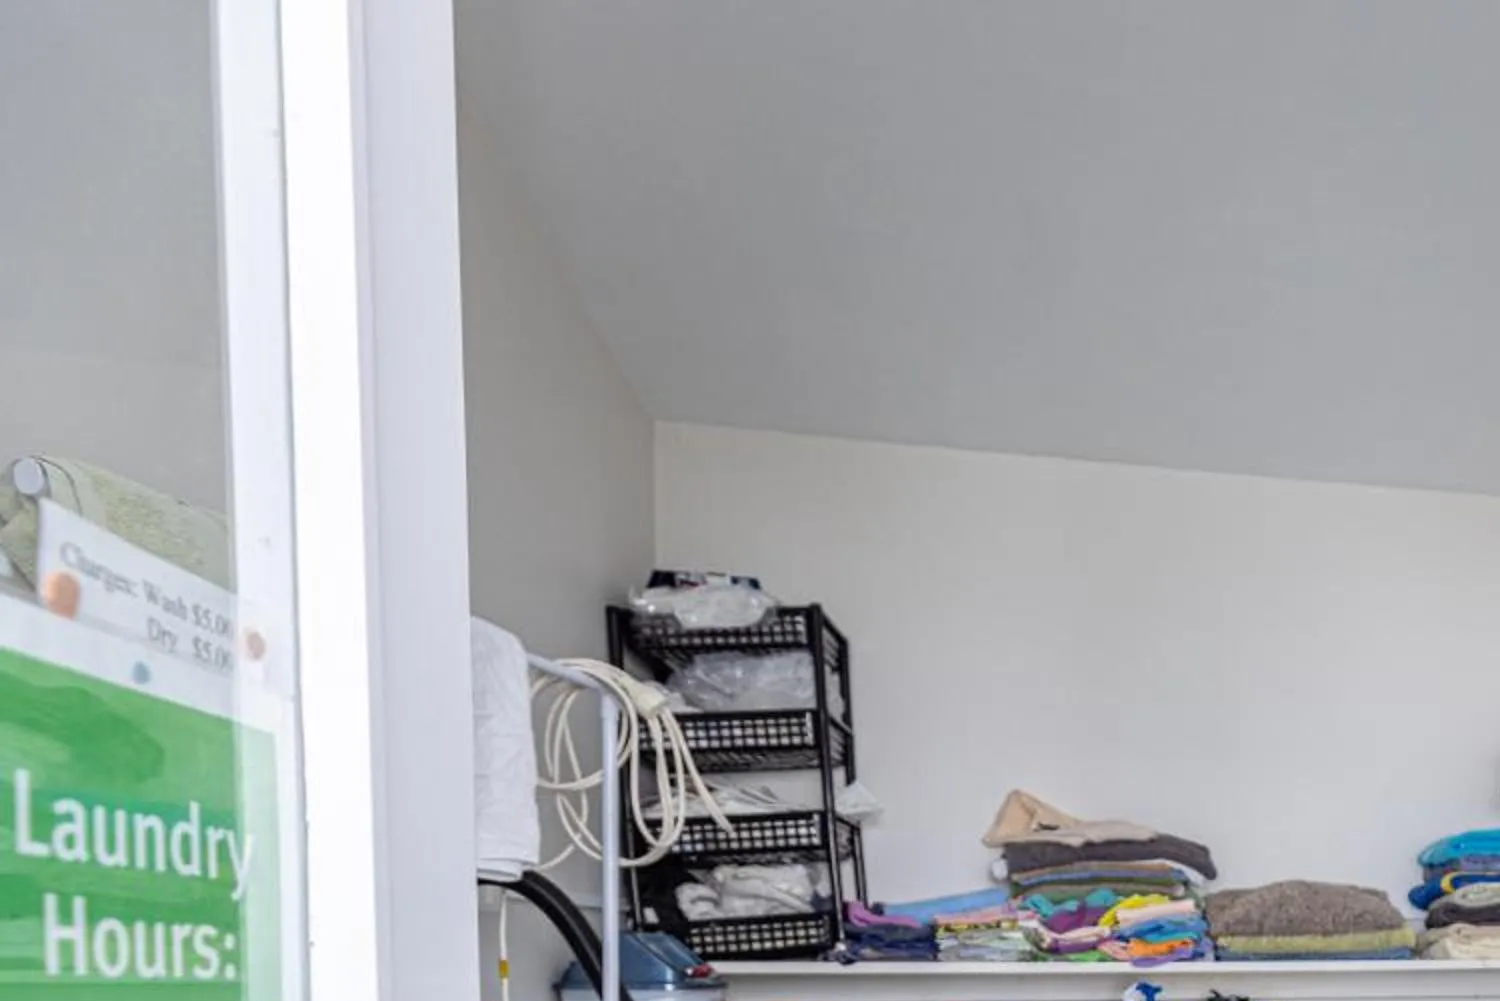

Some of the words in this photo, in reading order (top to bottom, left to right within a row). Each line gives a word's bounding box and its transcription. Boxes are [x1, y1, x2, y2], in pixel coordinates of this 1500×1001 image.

[147, 615, 178, 654] Dry
[14, 767, 255, 901] Laundry
[43, 892, 238, 980] Hours:
